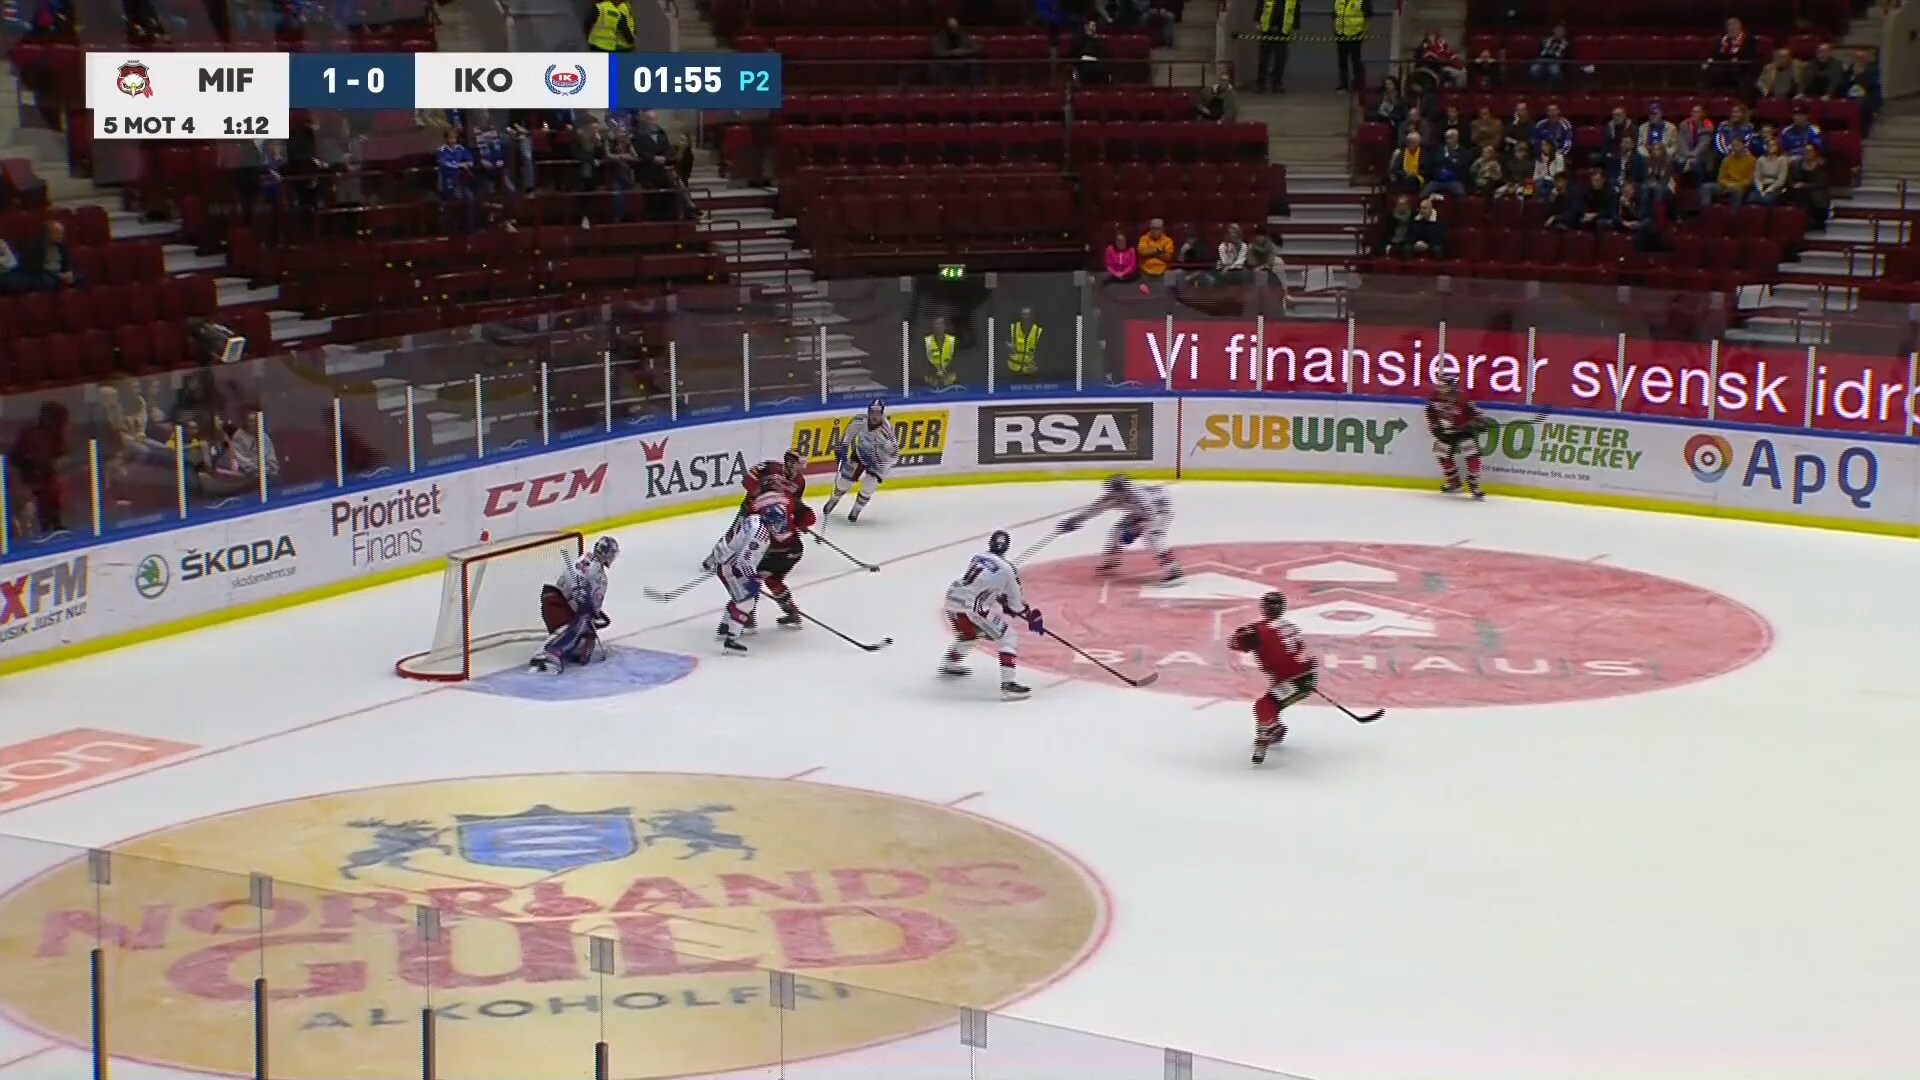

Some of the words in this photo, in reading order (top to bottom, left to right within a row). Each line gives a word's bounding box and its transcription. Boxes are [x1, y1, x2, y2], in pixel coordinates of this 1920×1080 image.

[1145, 331, 1200, 381] Vi
[1224, 332, 1549, 396] finansierar
[1571, 360, 1789, 415] svensk
[797, 417, 943, 457] BLÅDER
[993, 413, 1130, 455] RSA
[1200, 413, 1409, 456] SUBWAY
[1476, 415, 1536, 461] 00
[1539, 441, 1644, 471] HOCKEY
[1540, 422, 1630, 450] METER
[482, 462, 609, 519] CCM
[644, 450, 748, 499] RASTA
[1742, 438, 1879, 509] ApQ
[331, 482, 442, 537] Prioritet
[181, 534, 297, 582] ŠKODA
[352, 527, 424, 567] Finans
[31, 609, 63, 632] JUST
[1072, 647, 1644, 677] BAHAUS
[32, 862, 1049, 959] NORRLANDS
[164, 904, 961, 1002] GULD
[300, 980, 853, 1031] ALKOHOLFRI
